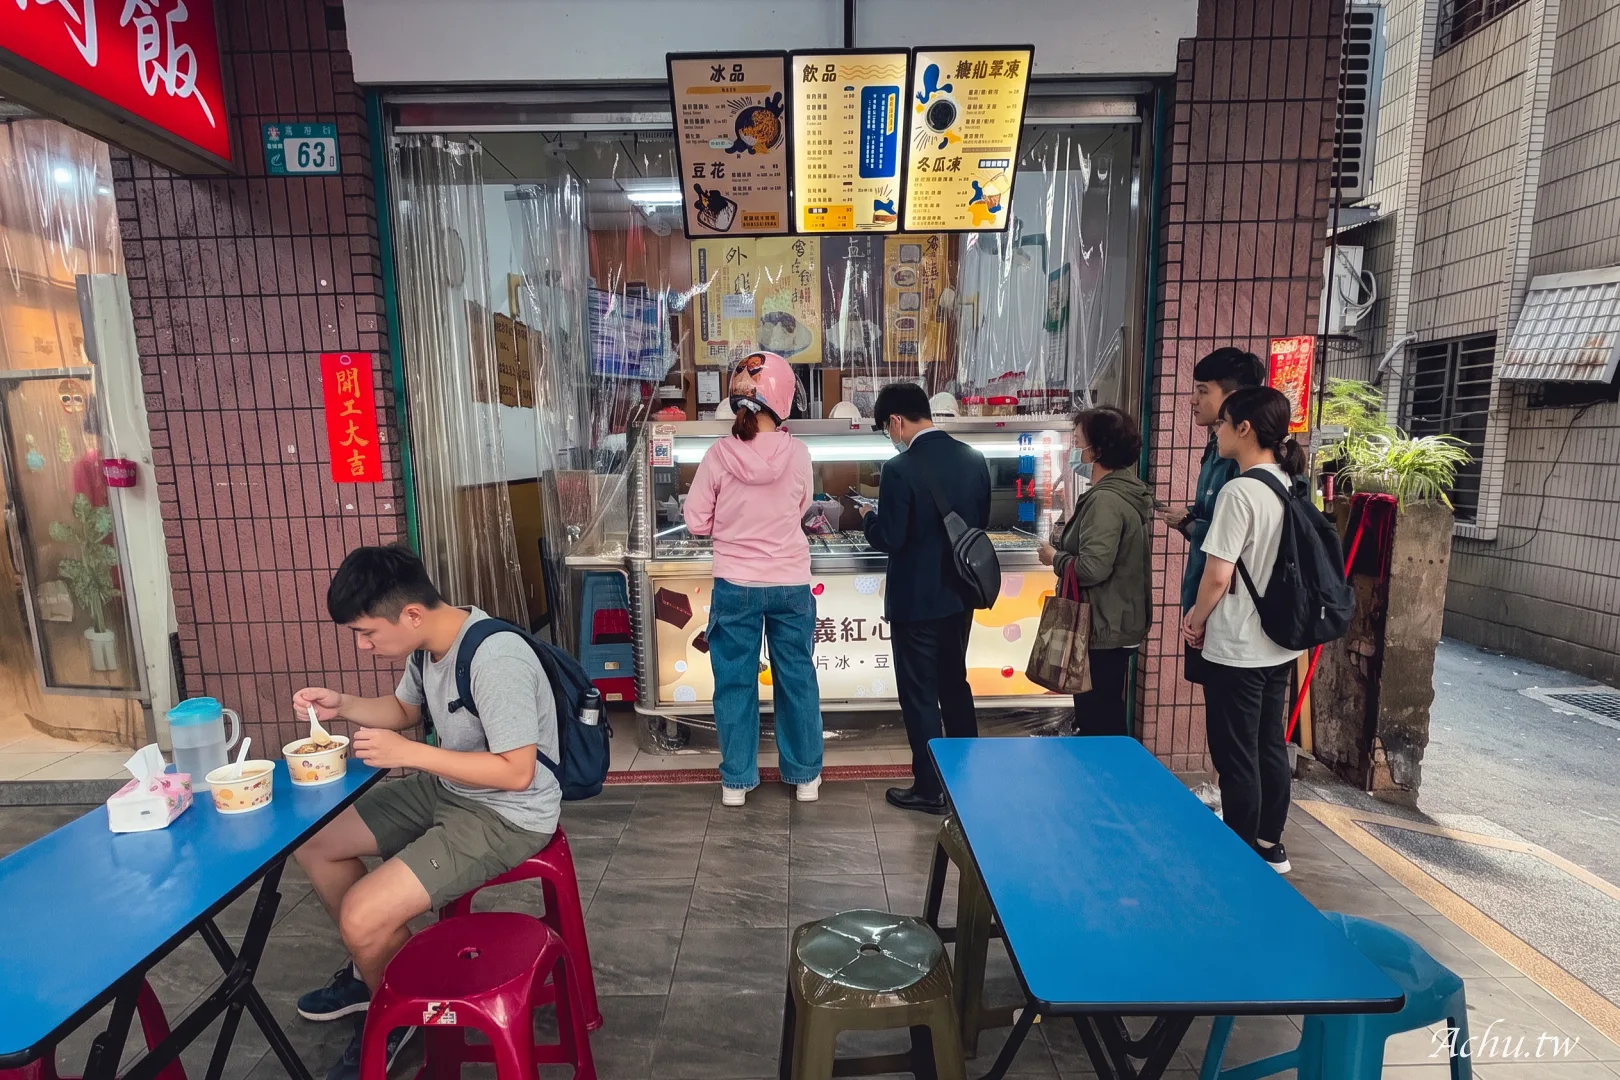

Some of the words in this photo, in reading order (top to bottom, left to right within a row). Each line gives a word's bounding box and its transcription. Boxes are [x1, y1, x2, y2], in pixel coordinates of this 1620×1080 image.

[709, 63, 745, 83] 冰品
[802, 64, 837, 83] 飲品
[298, 141, 326, 168] 63
[917, 156, 963, 173] 冬瓜凍
[691, 161, 726, 179] 豆花
[335, 367, 370, 477] 開工大吉
[1015, 477, 1036, 499] 14
